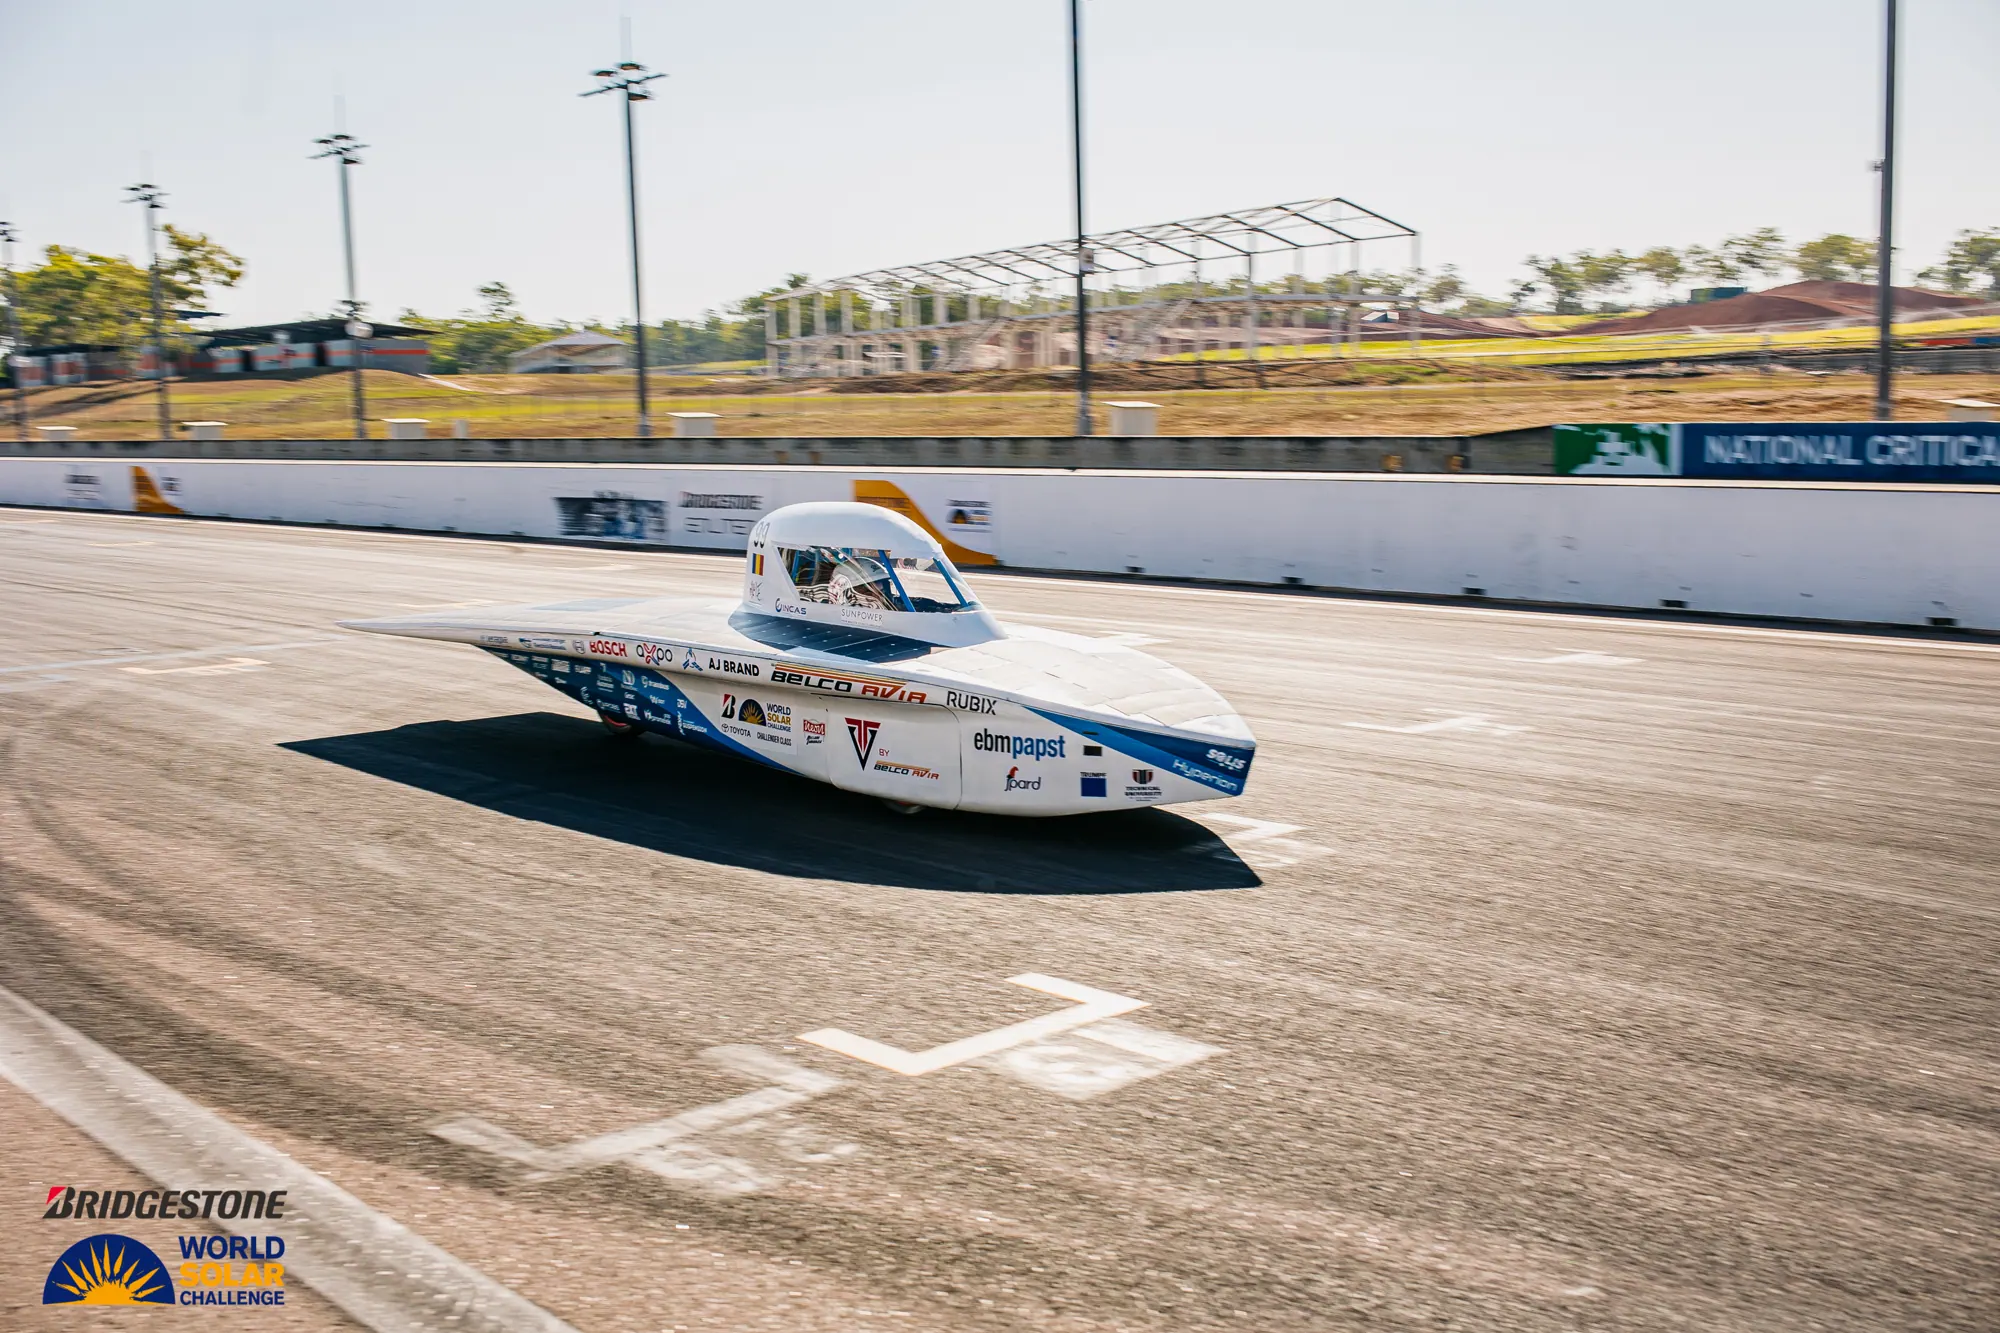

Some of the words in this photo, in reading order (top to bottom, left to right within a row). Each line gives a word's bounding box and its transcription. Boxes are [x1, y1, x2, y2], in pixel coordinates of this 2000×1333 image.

[1704, 434, 1863, 466] NATIONAL
[753, 521, 770, 548] 99
[782, 604, 807, 615] INCAS
[841, 608, 883, 622] SUNPOWER
[589, 640, 628, 657] BOSCH
[708, 657, 721, 671] AJ
[723, 660, 760, 677] BRAND
[770, 670, 853, 693] BELCO
[861, 684, 927, 704] AVIA
[766, 703, 791, 716] WORLD
[946, 691, 997, 715] RUBIX
[766, 713, 791, 725] SOLAR
[729, 726, 751, 737] TOYOTA
[767, 722, 791, 732] CHALLENGE
[756, 731, 780, 744] CHALLENGER
[779, 737, 792, 746] CLASS
[974, 728, 1066, 761] ebmpapst
[879, 748, 890, 757] BY
[911, 770, 940, 780] AVIA
[1172, 759, 1238, 791] Hyperion
